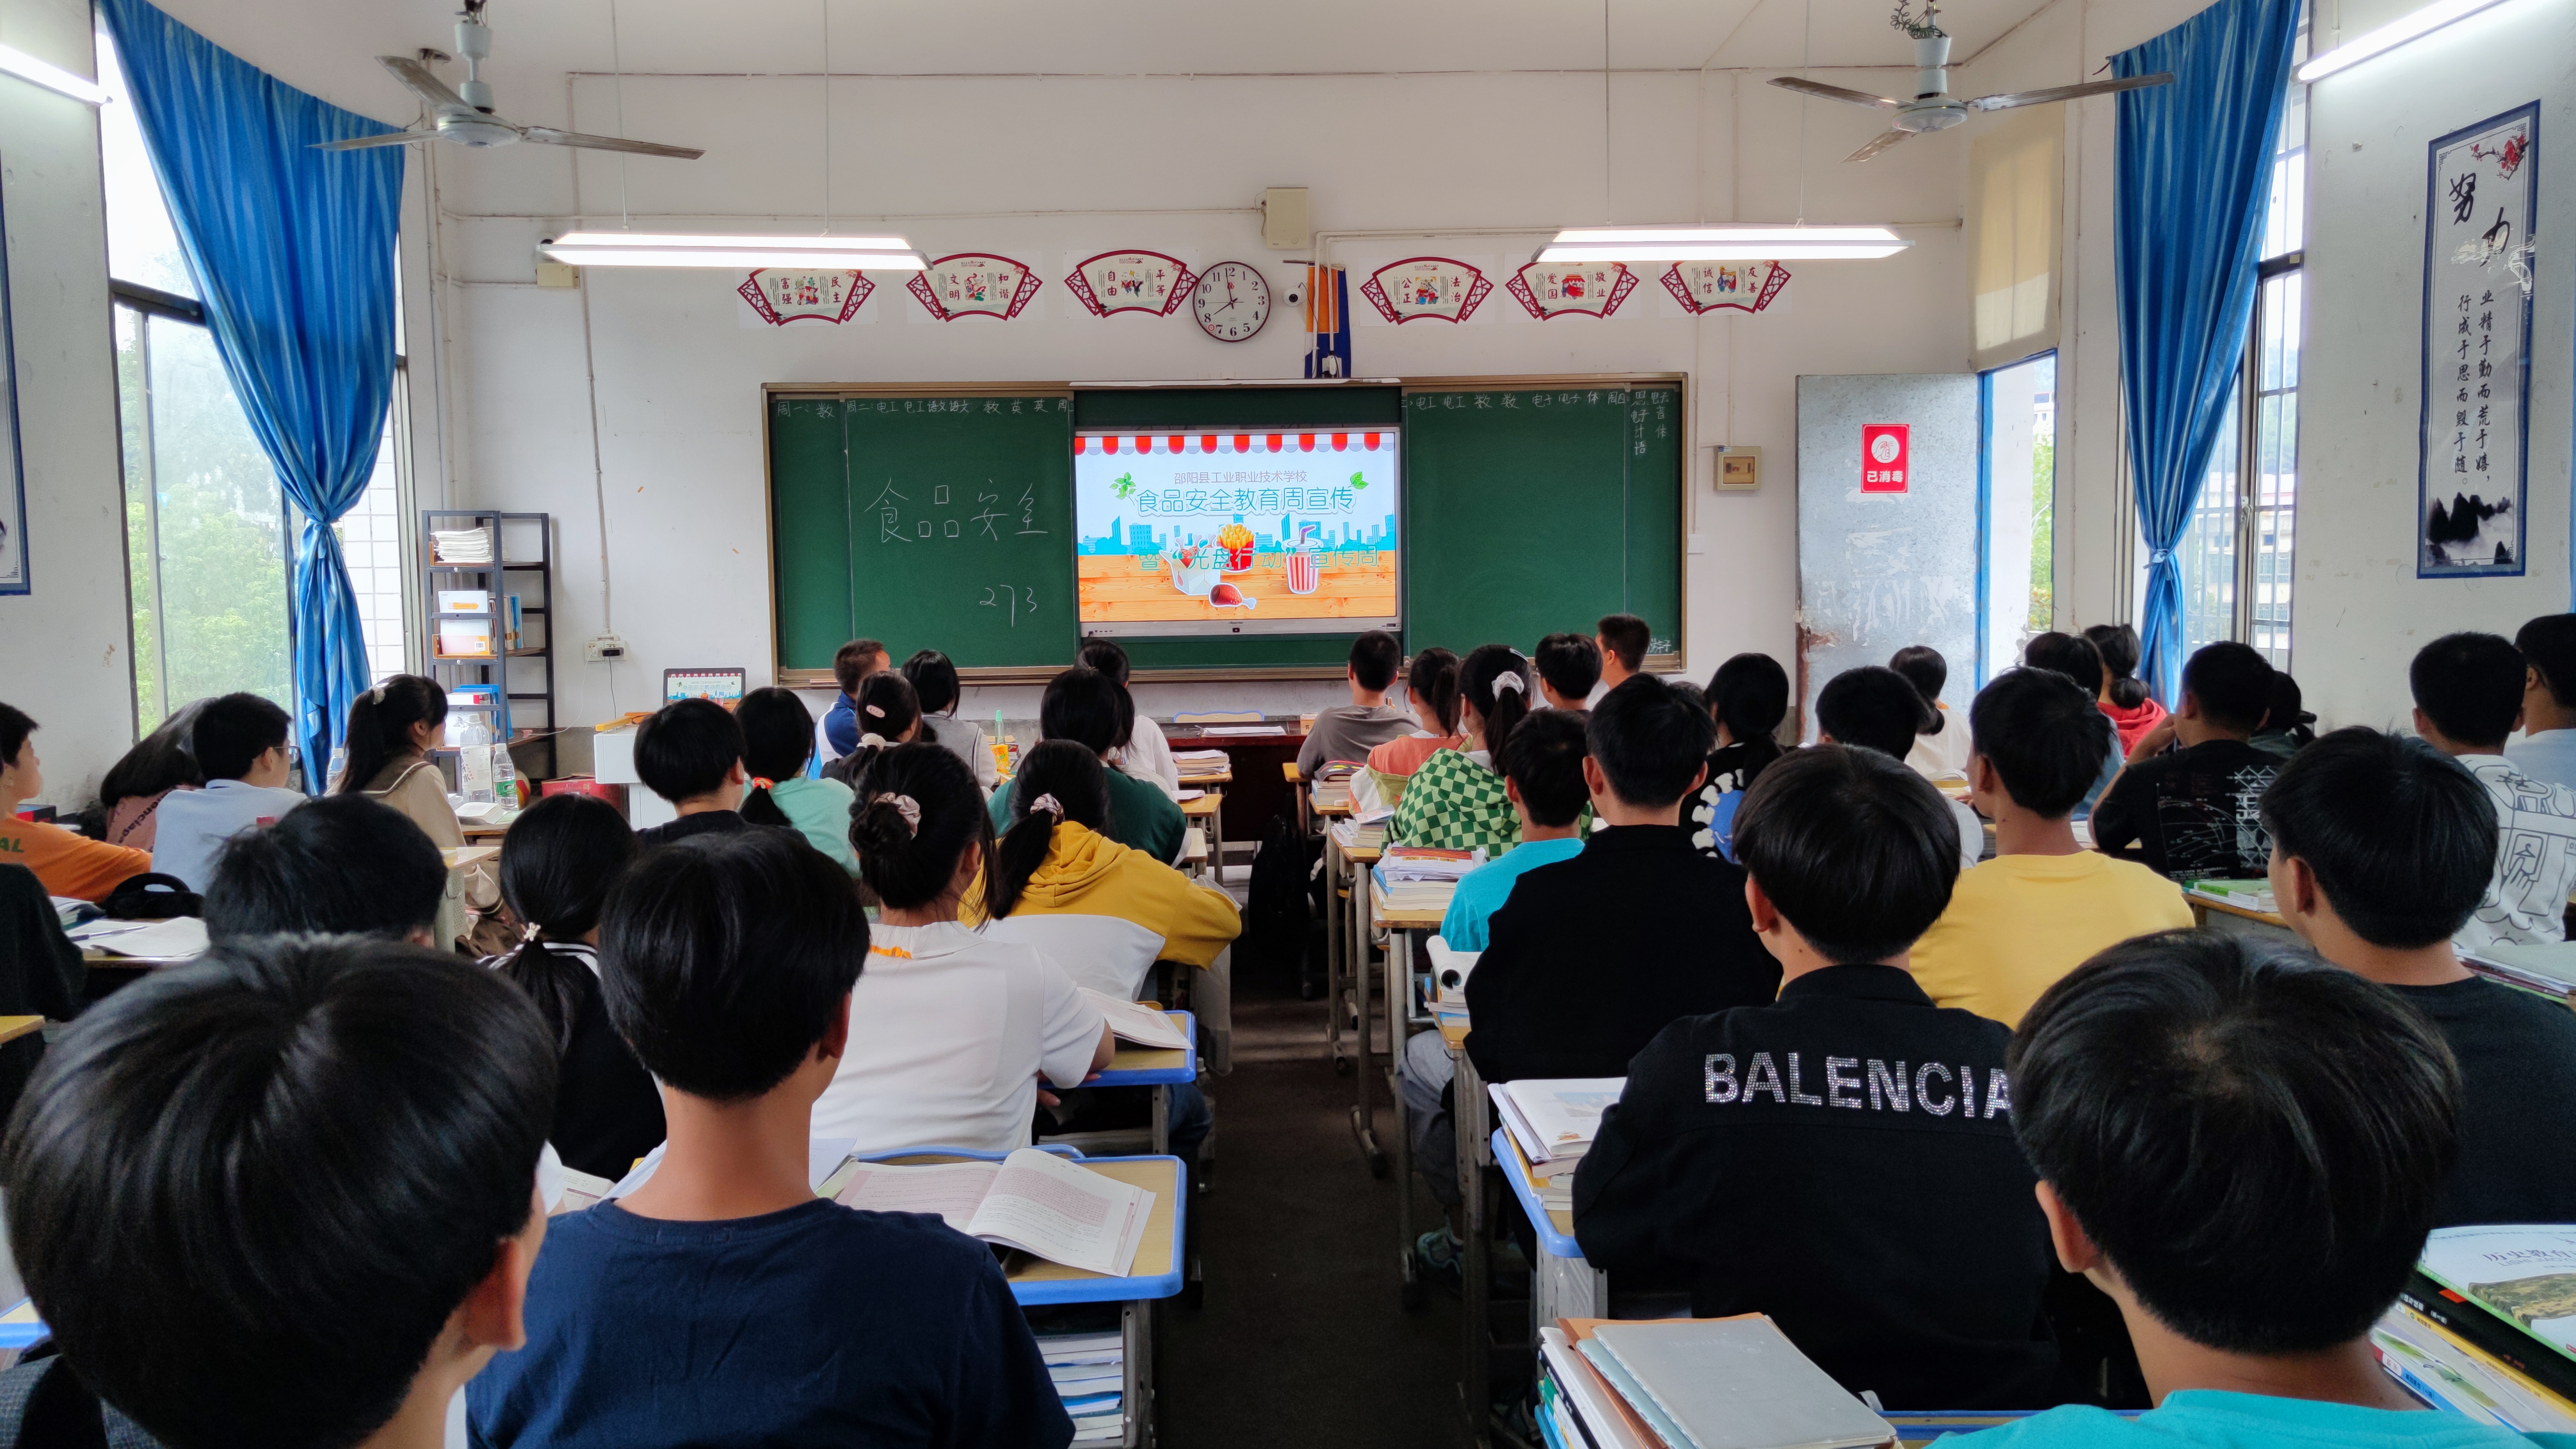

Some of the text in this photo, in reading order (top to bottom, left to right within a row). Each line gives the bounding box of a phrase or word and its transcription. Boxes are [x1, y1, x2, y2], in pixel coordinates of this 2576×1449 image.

[949, 274, 960, 301] 文明
[998, 273, 1010, 300] 和谐
[1107, 270, 1117, 297] 自由
[1155, 269, 1166, 297] 平等
[1201, 283, 1212, 293] 10
[1212, 271, 1220, 282] 11
[1242, 271, 1246, 280] 1
[1251, 281, 1259, 291] 2
[1547, 273, 1558, 300] 爱国
[1594, 271, 1607, 298] 敬业
[1703, 267, 1714, 294] 诚信
[1747, 266, 1758, 293] 友善
[781, 277, 792, 306] 富强
[830, 275, 842, 305] 民主
[1258, 296, 1265, 305] 3
[1402, 278, 1413, 304] 公正
[1450, 275, 1462, 303] 法治
[1198, 298, 1205, 309] 9
[1252, 310, 1259, 321] 4
[1204, 313, 1212, 323] 8
[1216, 323, 1223, 334] 7
[1243, 322, 1250, 333] 5
[1230, 326, 1237, 337] 6
[1174, 470, 1308, 484] 邵阳县工业职业技术学校
[1866, 470, 1904, 483] 已消毒
[864, 477, 1049, 543] 食品安全
[1136, 486, 1354, 513] 食品安全教育周宣传
[1703, 1051, 2012, 1119] BALENCIA
